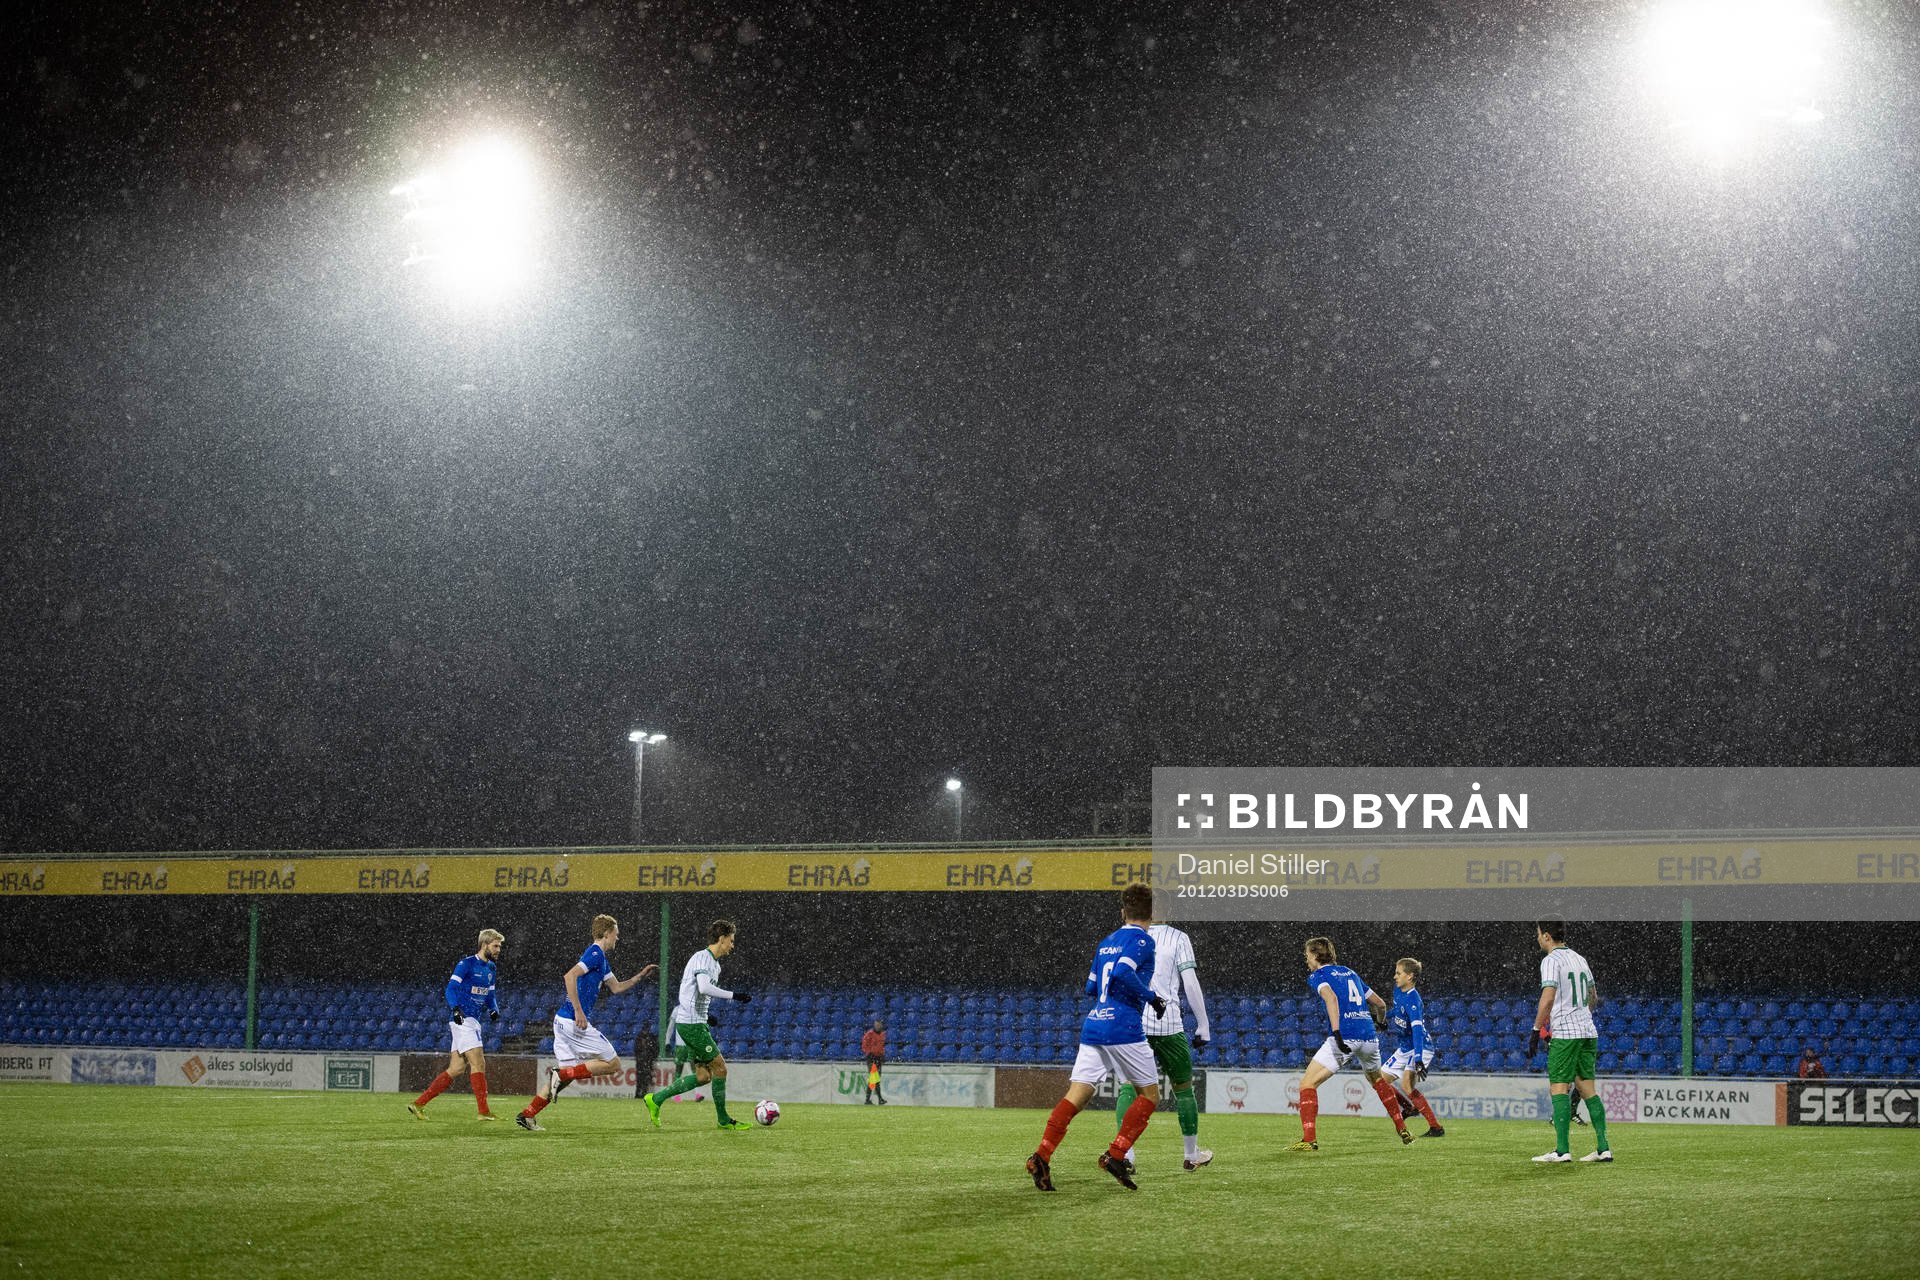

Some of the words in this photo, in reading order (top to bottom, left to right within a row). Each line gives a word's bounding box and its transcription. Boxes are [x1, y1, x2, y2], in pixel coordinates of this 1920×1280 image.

[1347, 979, 1362, 1006] 4
[1568, 971, 1588, 1008] 10
[207, 1056, 235, 1071] åkes
[239, 1057, 293, 1076] solskydd
[1644, 1088, 1749, 1102] FÄLGFIXARN
[1481, 1100, 1538, 1118] BYGG
[1643, 1105, 1730, 1119] DÄCKMAN
